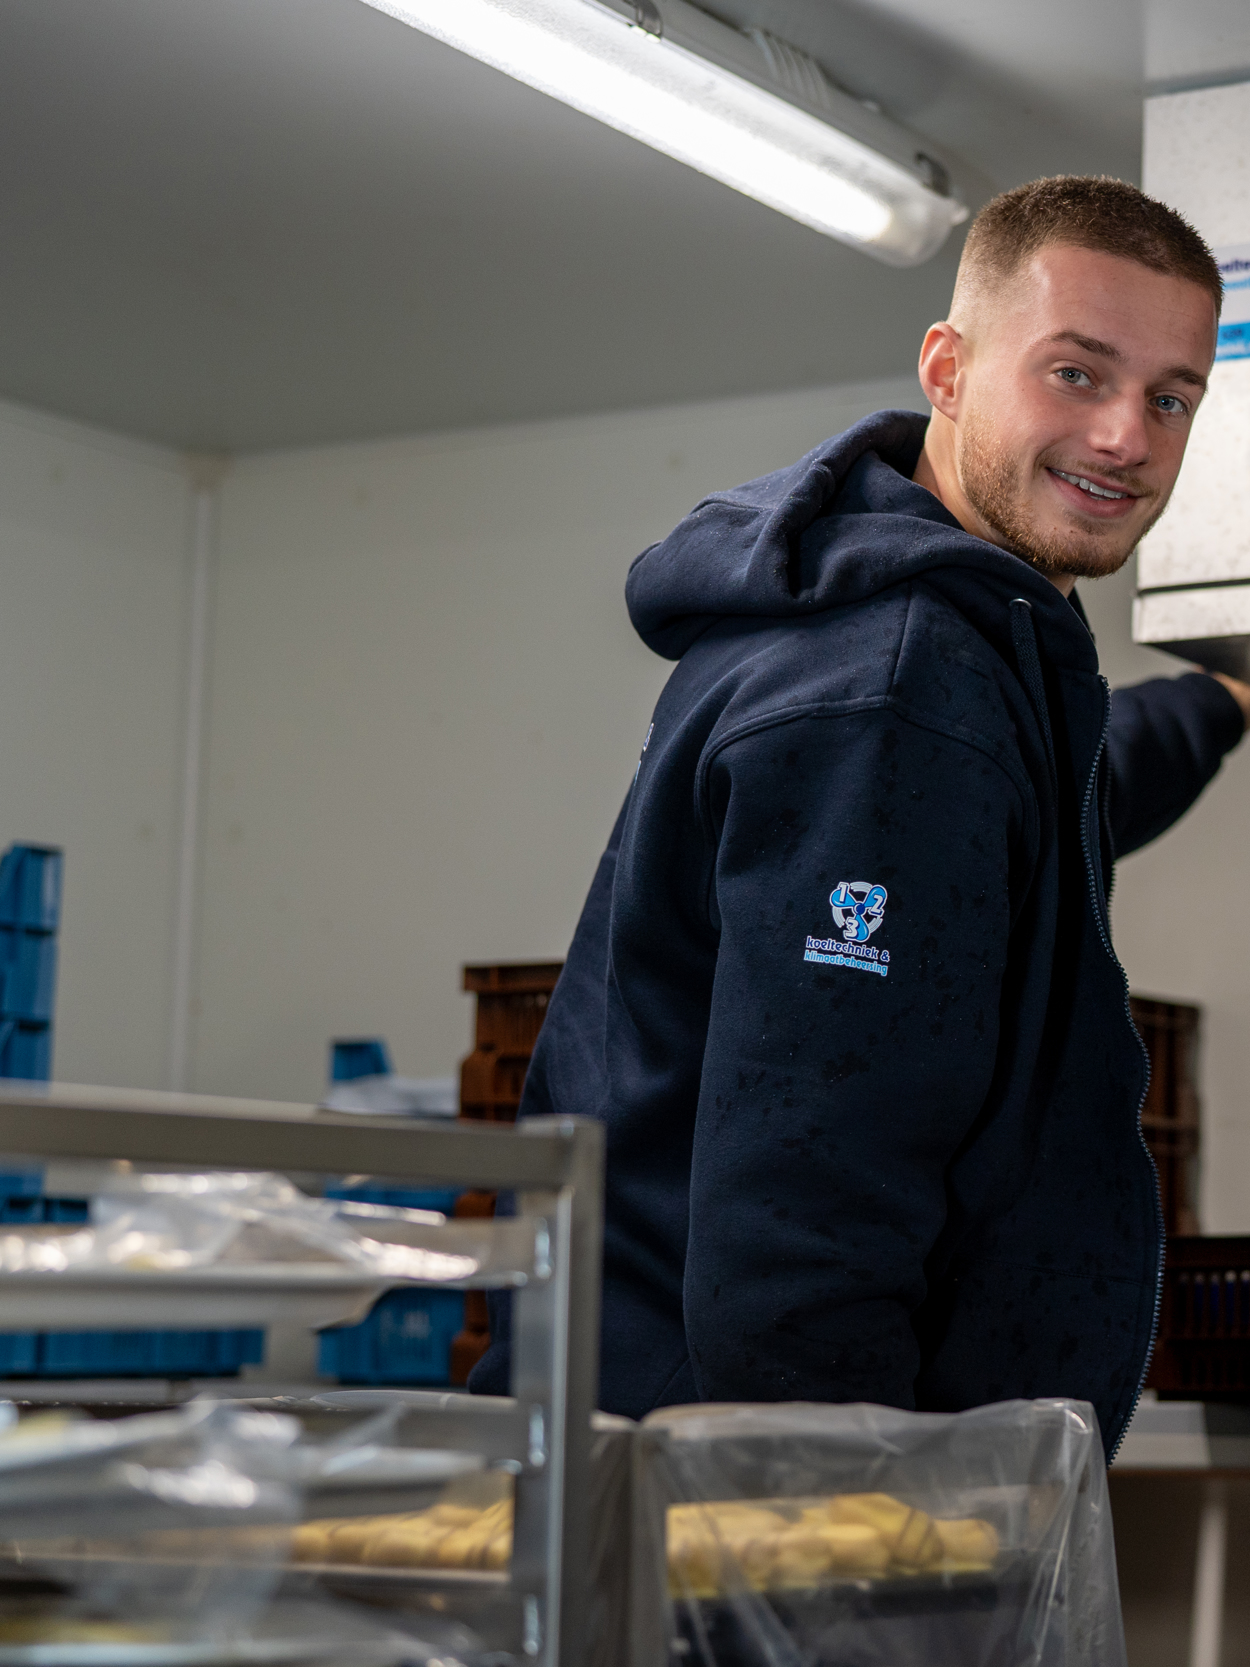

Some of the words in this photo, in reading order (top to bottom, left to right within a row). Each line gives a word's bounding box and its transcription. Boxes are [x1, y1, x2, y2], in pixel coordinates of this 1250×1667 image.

[806, 936, 879, 960] koeltechniek
[880, 950, 890, 962] &
[804, 950, 888, 977] klimaatbeheersing
